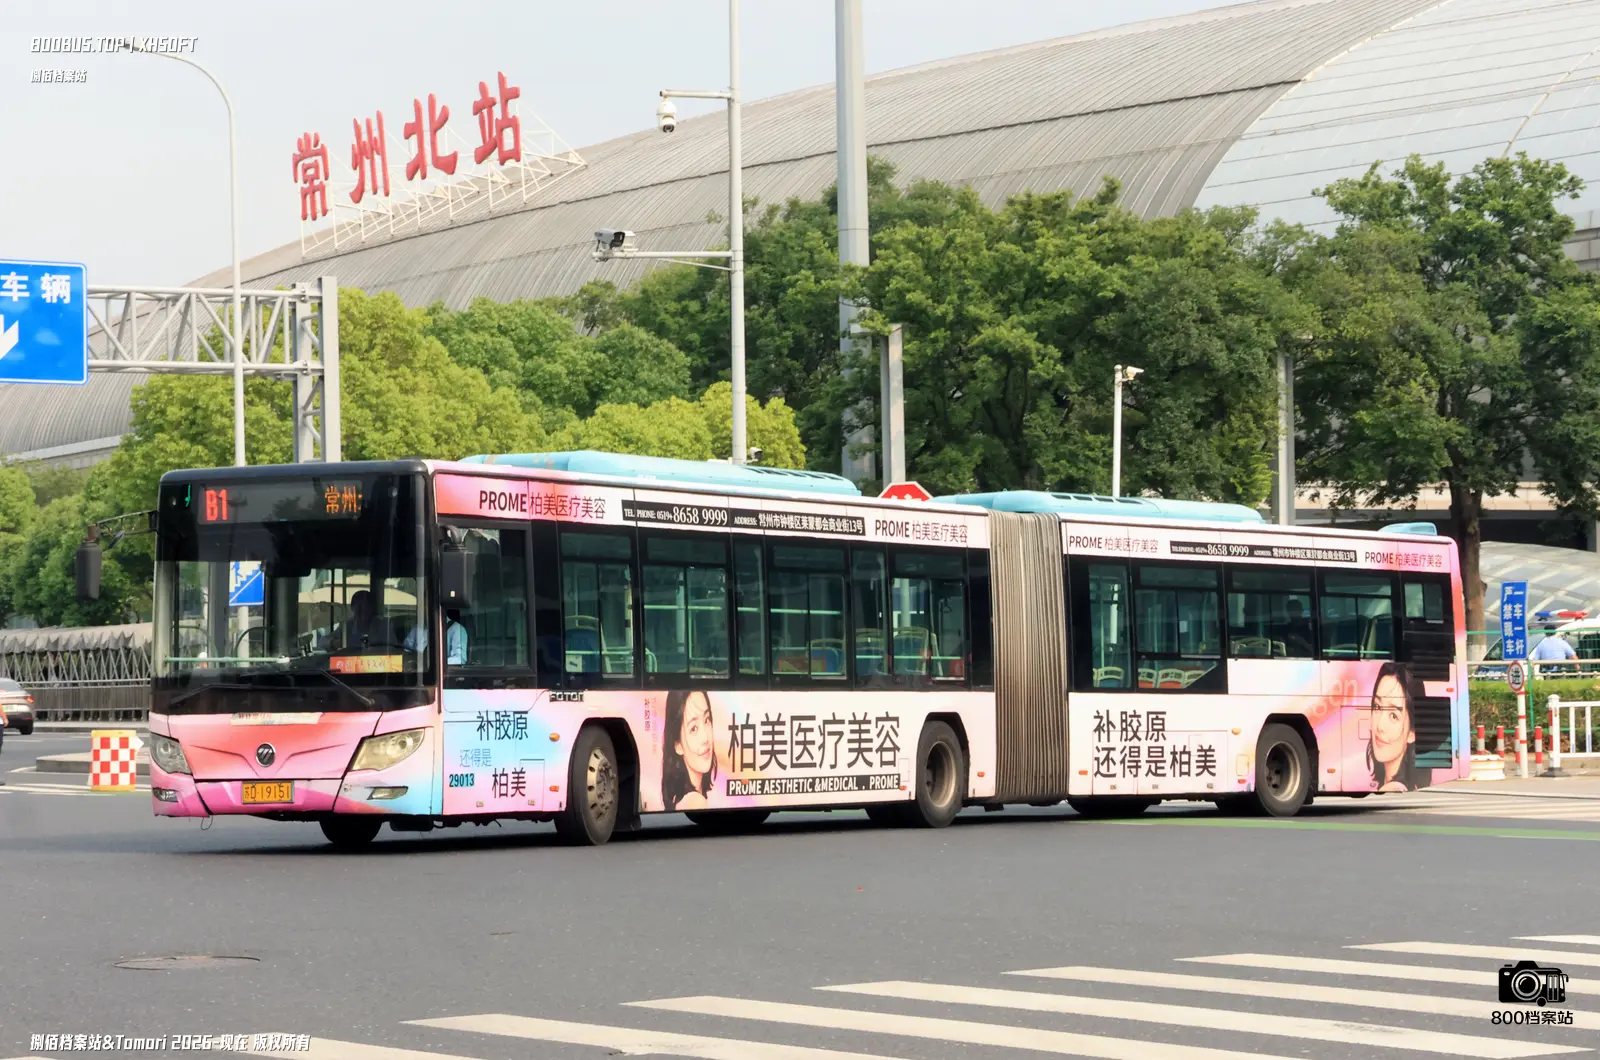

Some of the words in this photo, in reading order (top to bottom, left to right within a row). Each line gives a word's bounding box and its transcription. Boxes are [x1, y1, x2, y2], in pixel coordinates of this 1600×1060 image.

[292, 71, 522, 221] 常州北站
[0, 271, 71, 304] 车辆
[205, 488, 229, 521] B1
[324, 485, 363, 514] 常州
[479, 490, 527, 512] PROME
[530, 492, 606, 519] 柏美医疗美容
[702, 508, 728, 526] 9999
[875, 519, 910, 538] PROME
[912, 521, 968, 543] 柏美医疗美容
[1069, 536, 1102, 549] PROME
[1104, 537, 1158, 553] 柏美医疗美容
[1365, 552, 1394, 564] PROME
[1395, 553, 1443, 567] 柏美医疗美容
[476, 710, 528, 741] 补胶原
[1093, 709, 1167, 743] 补胶原
[728, 712, 900, 773] 柏美医疗美容
[459, 748, 492, 768] 还得是
[1093, 744, 1217, 778] 还得是柏美
[449, 772, 475, 788] 29013
[491, 767, 527, 799] 柏美
[729, 779, 762, 796] PROME
[763, 777, 813, 794] AESTHETIC
[814, 775, 858, 792] &MEDICAL
[869, 774, 899, 790] PROME
